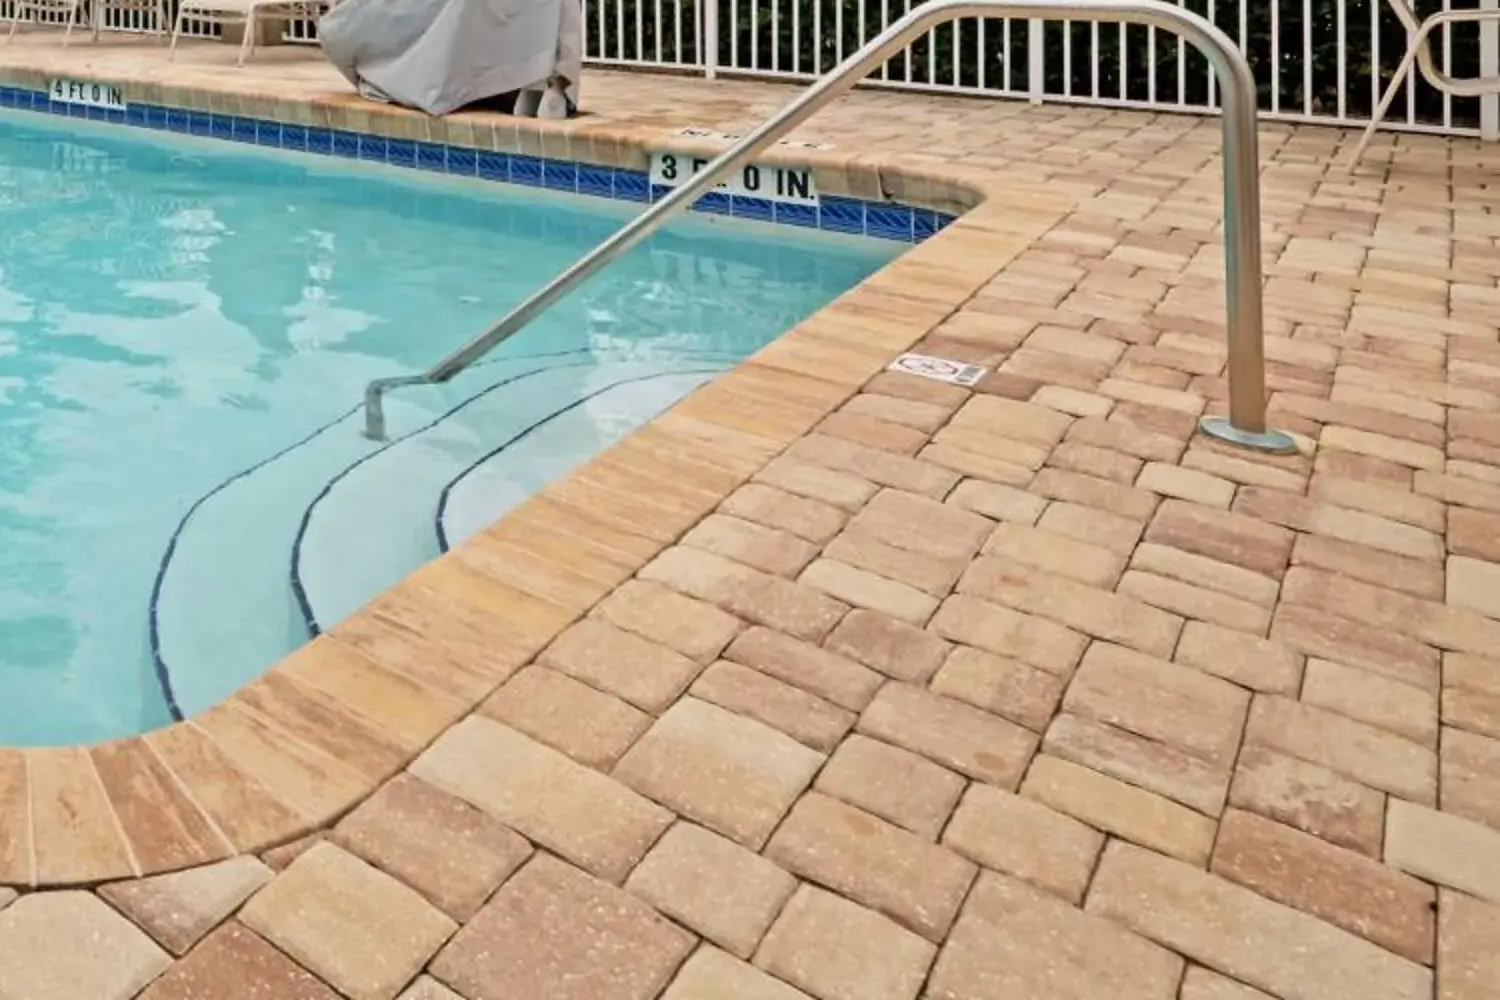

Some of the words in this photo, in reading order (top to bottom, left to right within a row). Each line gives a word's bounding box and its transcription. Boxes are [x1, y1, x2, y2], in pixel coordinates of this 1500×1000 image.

[55, 80, 63, 97] 4
[92, 84, 101, 102] 0
[661, 154, 677, 180] 3
[743, 165, 760, 191] 0
[777, 168, 815, 200] IN.
